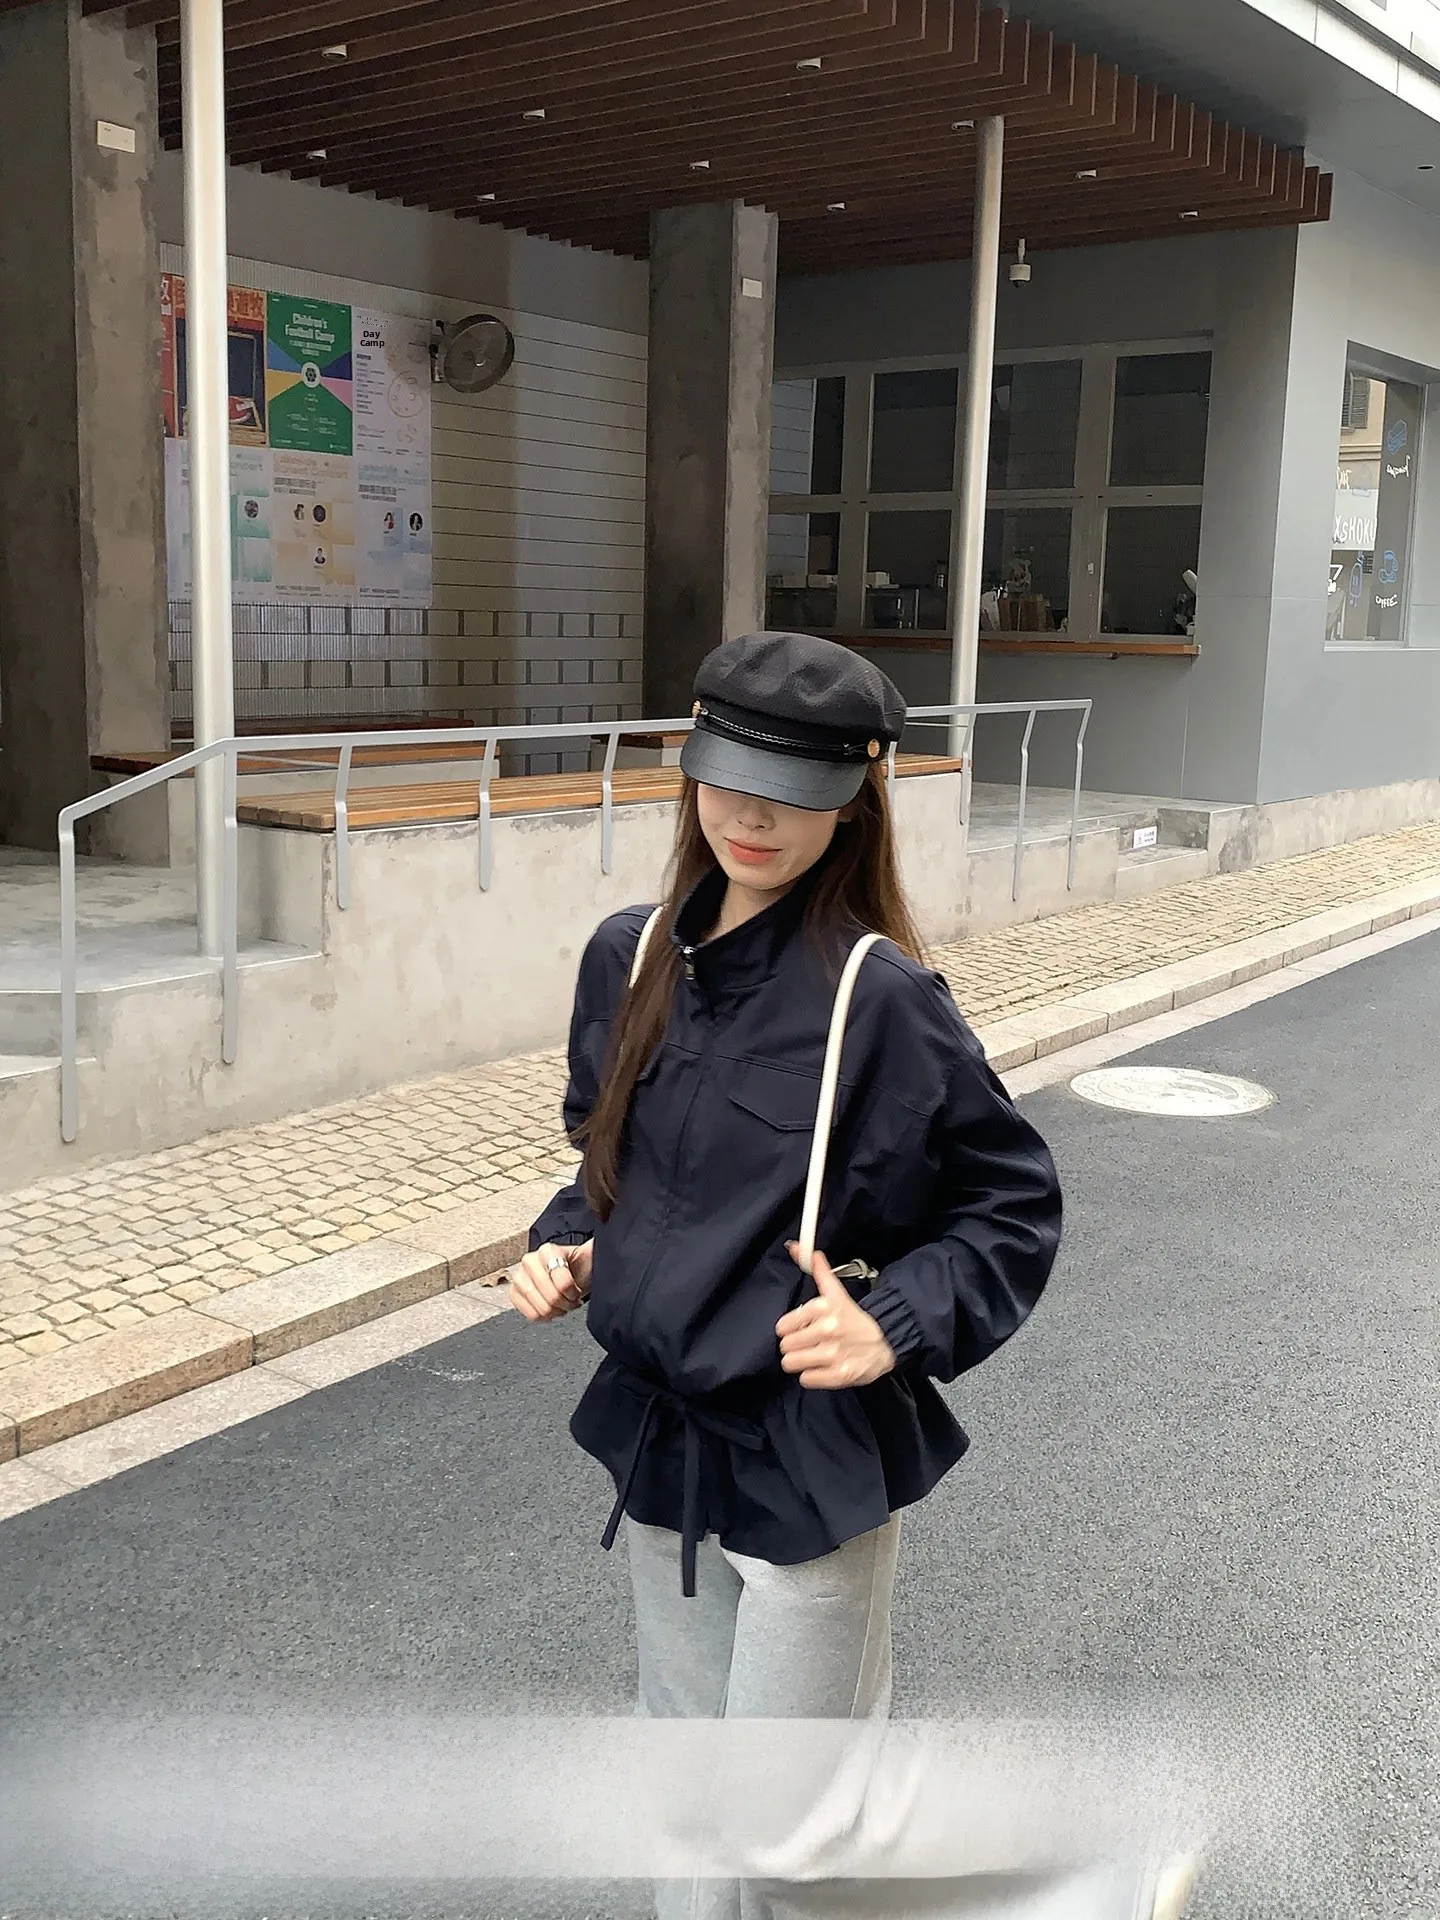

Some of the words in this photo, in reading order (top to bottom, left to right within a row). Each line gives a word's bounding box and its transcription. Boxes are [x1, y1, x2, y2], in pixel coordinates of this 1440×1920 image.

[292, 313, 328, 329] Children's
[285, 324, 315, 339] Football
[315, 329, 335, 344] Camp
[363, 330, 381, 340] Day
[360, 339, 385, 349] Camp
